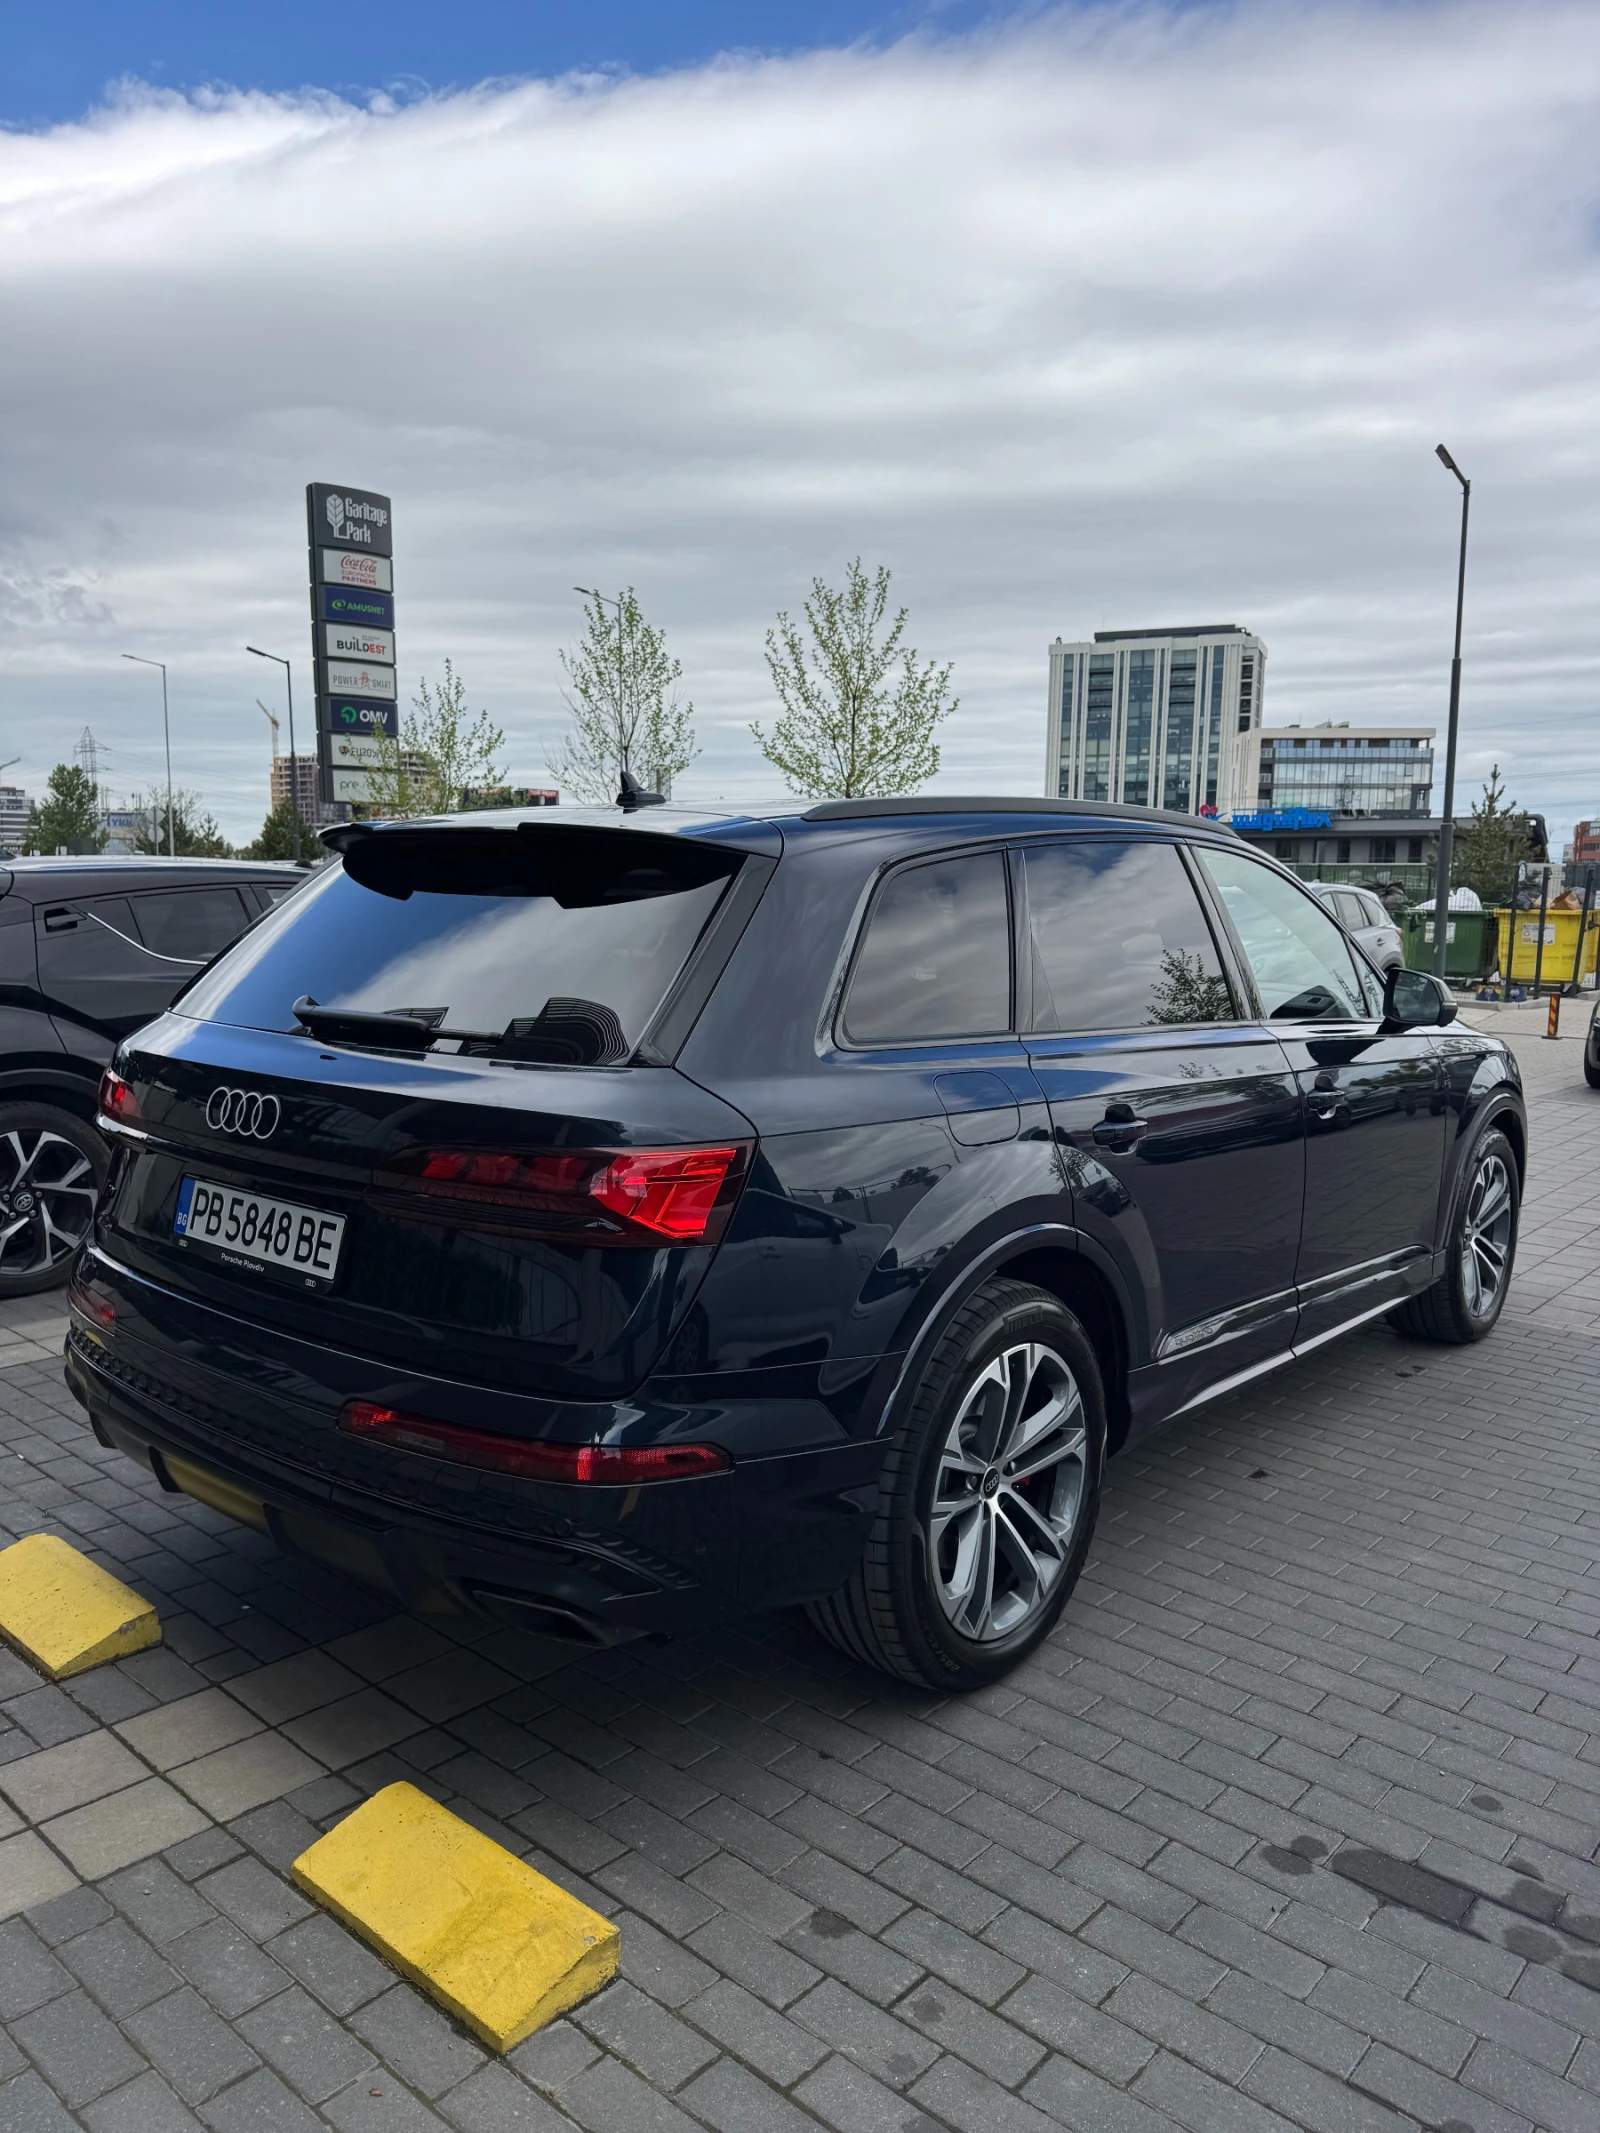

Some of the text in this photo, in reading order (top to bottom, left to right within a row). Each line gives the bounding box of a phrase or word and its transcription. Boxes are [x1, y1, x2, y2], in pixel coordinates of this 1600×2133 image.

[345, 497, 388, 527] Garitage
[346, 521, 371, 543] Park
[342, 575, 377, 586] PARTNERS
[347, 602, 385, 615] AMUSNET
[333, 674, 391, 690] POWER SMART
[359, 709, 388, 725] OMV
[1232, 807, 1333, 832] magniflex
[176, 1212, 188, 1226] BG
[221, 1252, 265, 1272] Porsche Plovdiv
[1174, 1327, 1214, 1347] quattro
